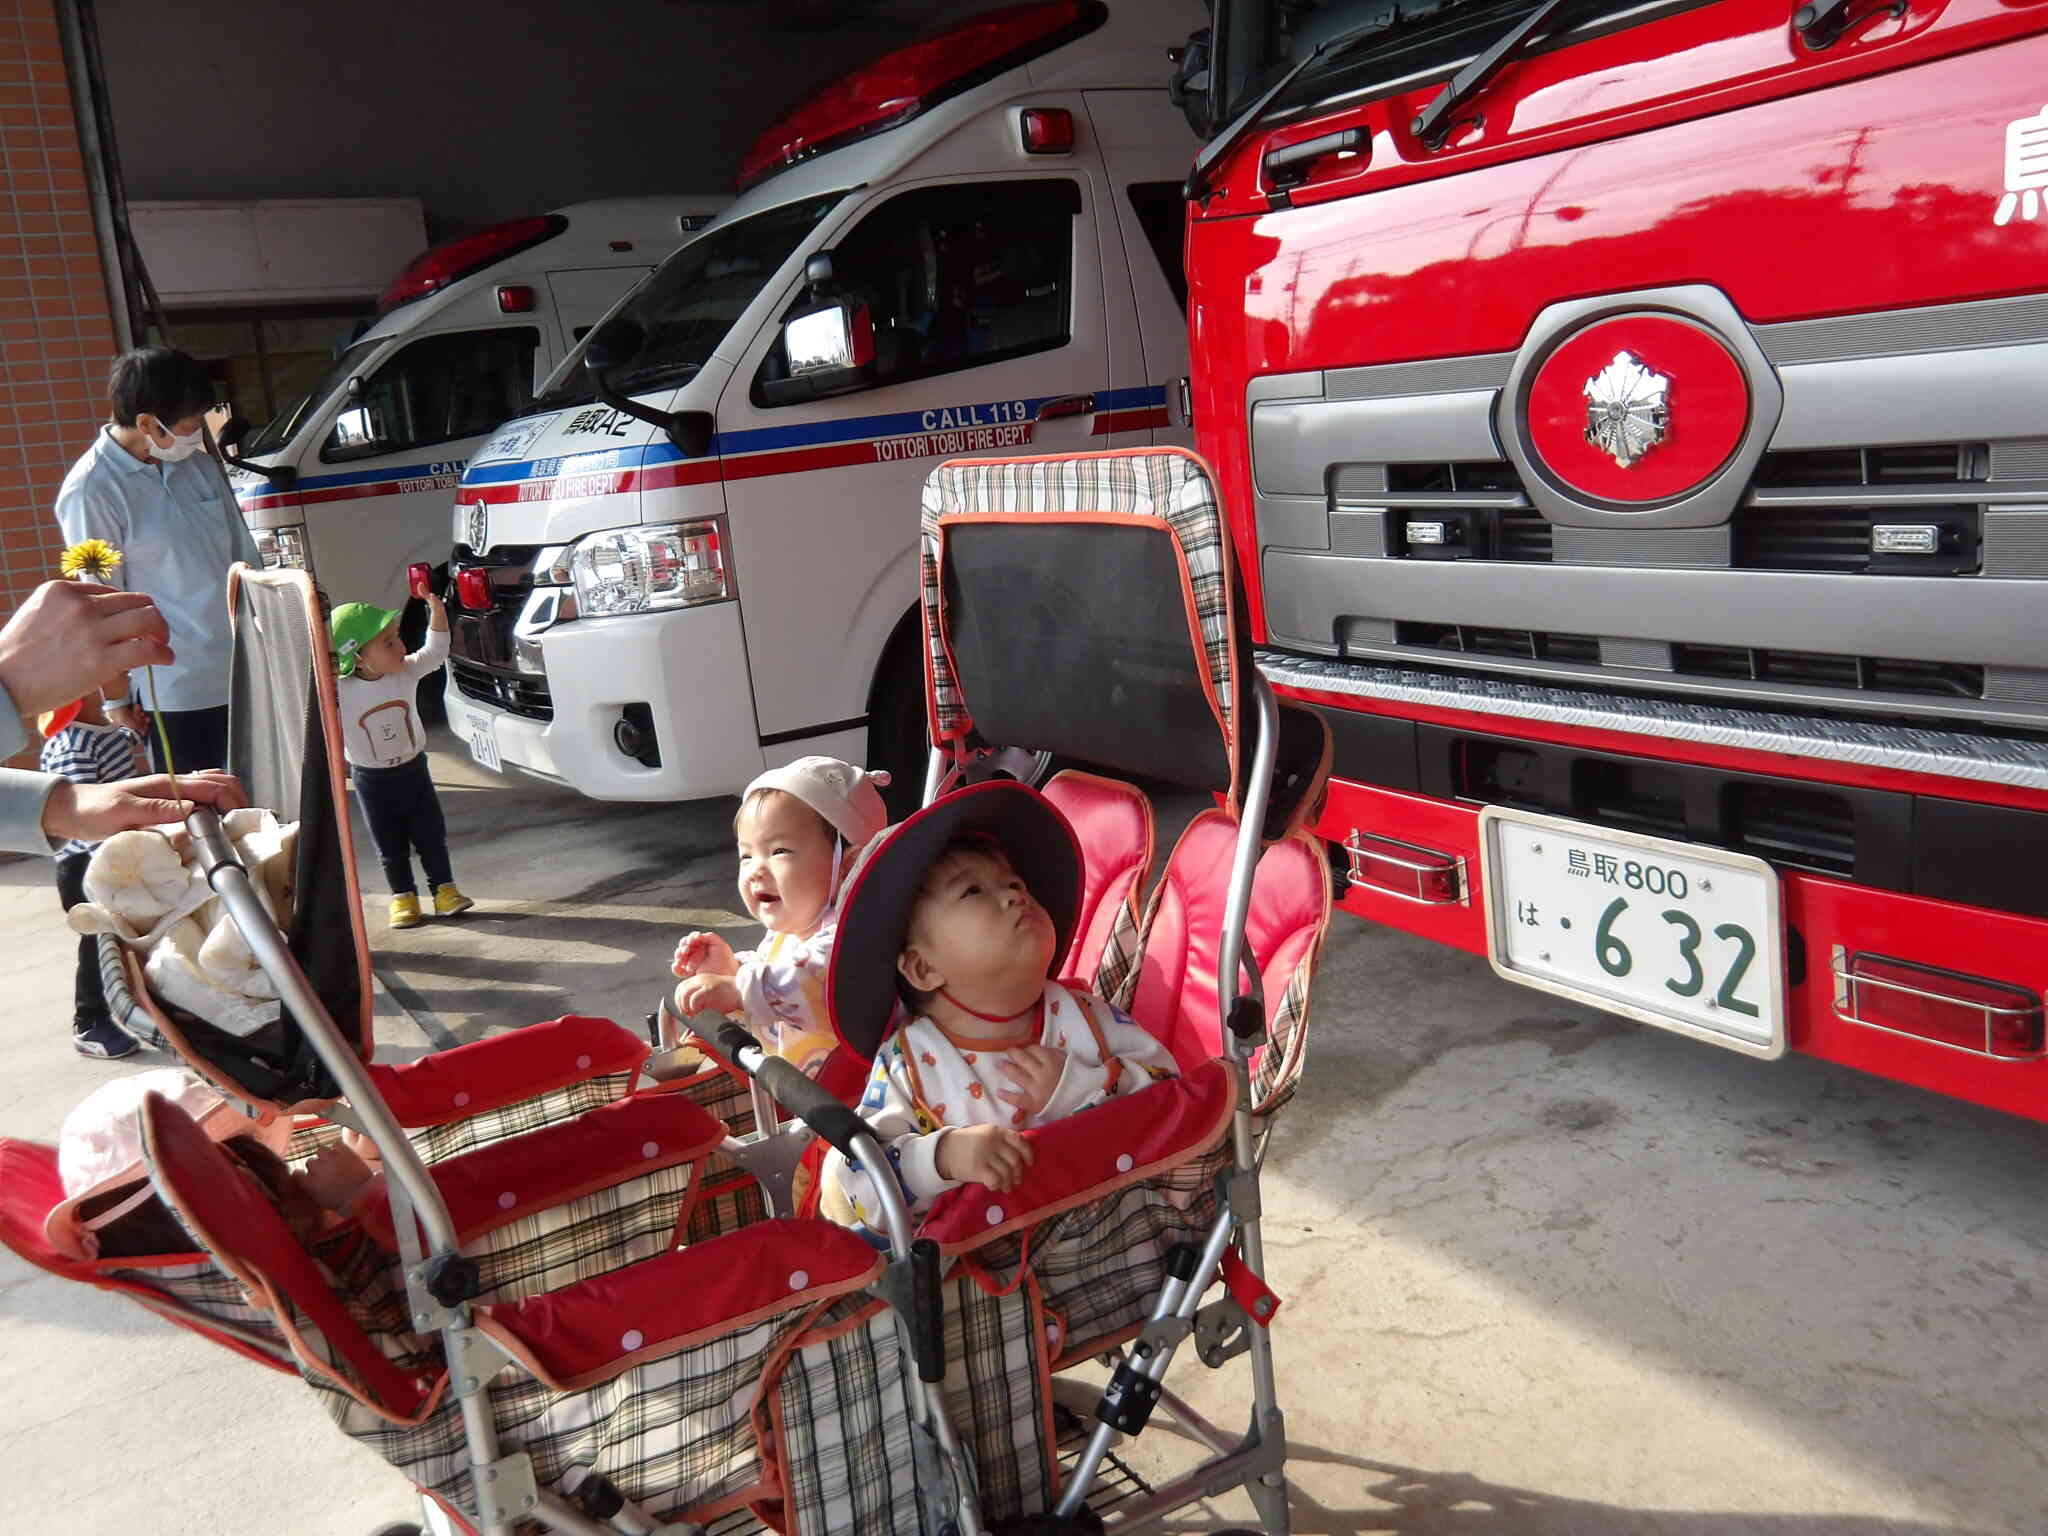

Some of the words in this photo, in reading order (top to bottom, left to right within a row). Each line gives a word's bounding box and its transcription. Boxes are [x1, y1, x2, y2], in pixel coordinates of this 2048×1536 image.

[922, 406, 983, 431] CALL
[990, 401, 1026, 423] 119
[873, 437, 930, 461] TOTTORI
[929, 432, 966, 455] TOBU
[967, 429, 994, 450] FIRE
[995, 425, 1031, 447] DEPT.
[398, 479, 435, 495] TOTTORI
